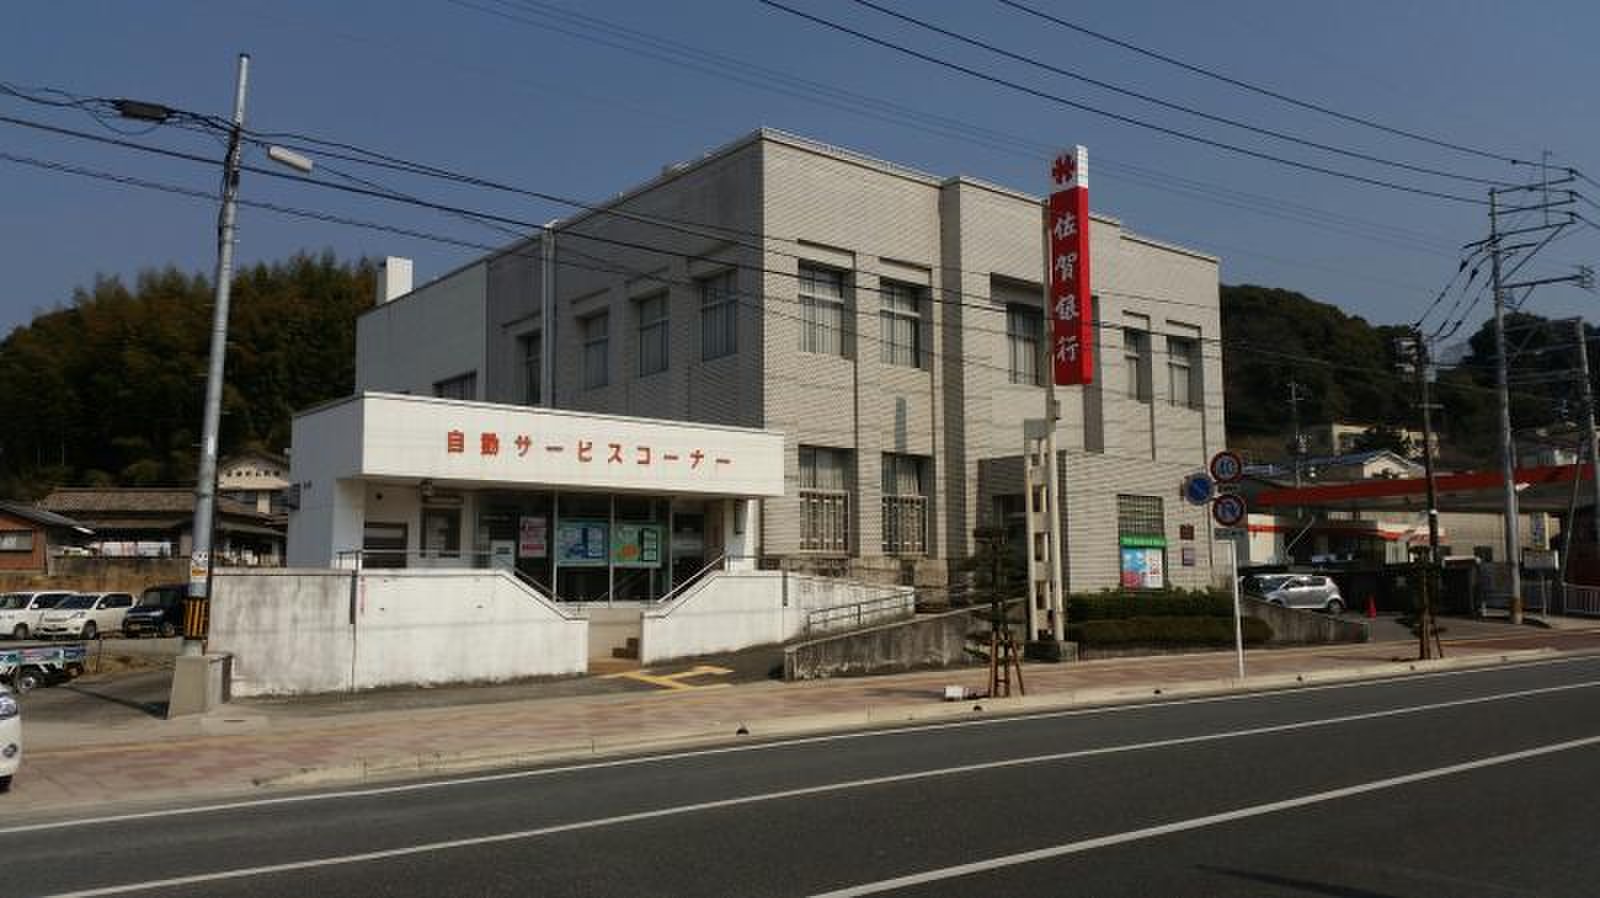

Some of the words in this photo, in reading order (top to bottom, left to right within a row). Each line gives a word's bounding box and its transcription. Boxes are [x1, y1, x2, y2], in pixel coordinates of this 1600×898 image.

[1055, 212, 1079, 363] 佐賀銀行
[447, 430, 731, 469] 自動サービスコーナー
